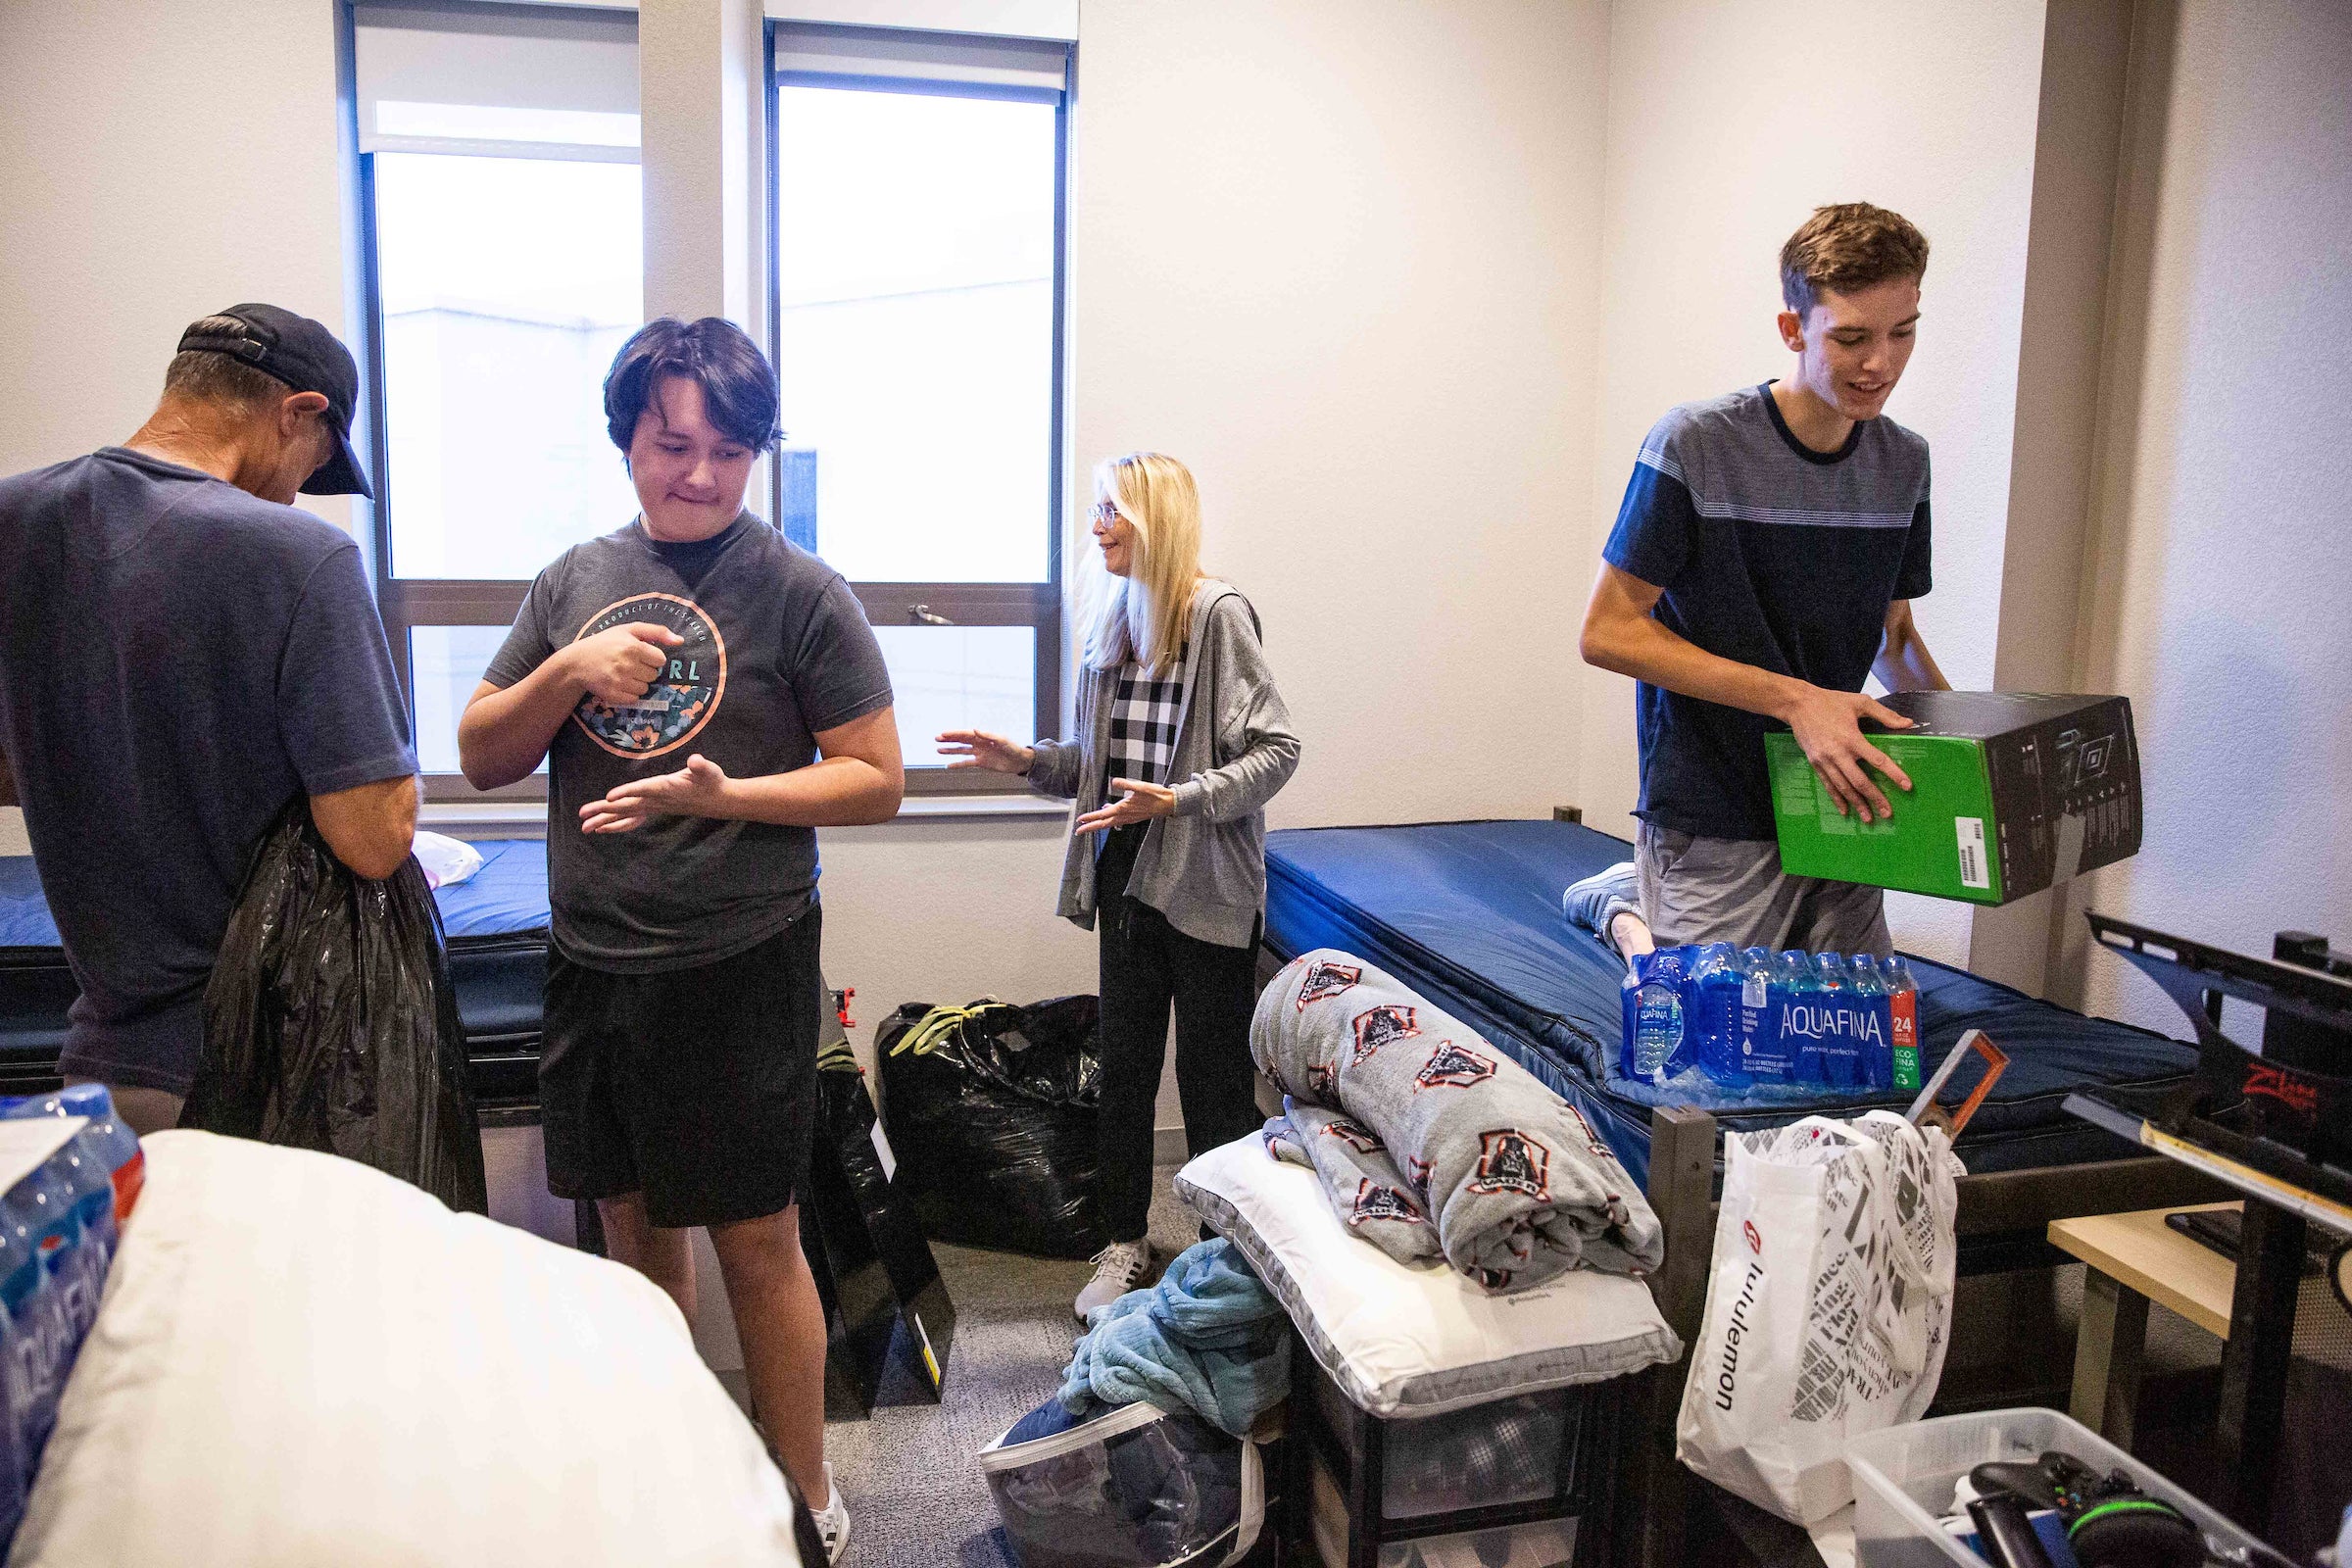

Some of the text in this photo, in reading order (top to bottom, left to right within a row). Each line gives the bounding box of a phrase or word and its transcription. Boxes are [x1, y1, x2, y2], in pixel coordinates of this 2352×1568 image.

[598, 605, 643, 630] PRODUCT
[662, 605, 681, 616] THE
[681, 612, 707, 642] SEARCH
[1780, 1003, 1885, 1048] AQUAFINA
[1893, 1016, 1912, 1033] 24
[1895, 1057, 1916, 1067] FINA
[1715, 1262, 1763, 1412] lululemon
